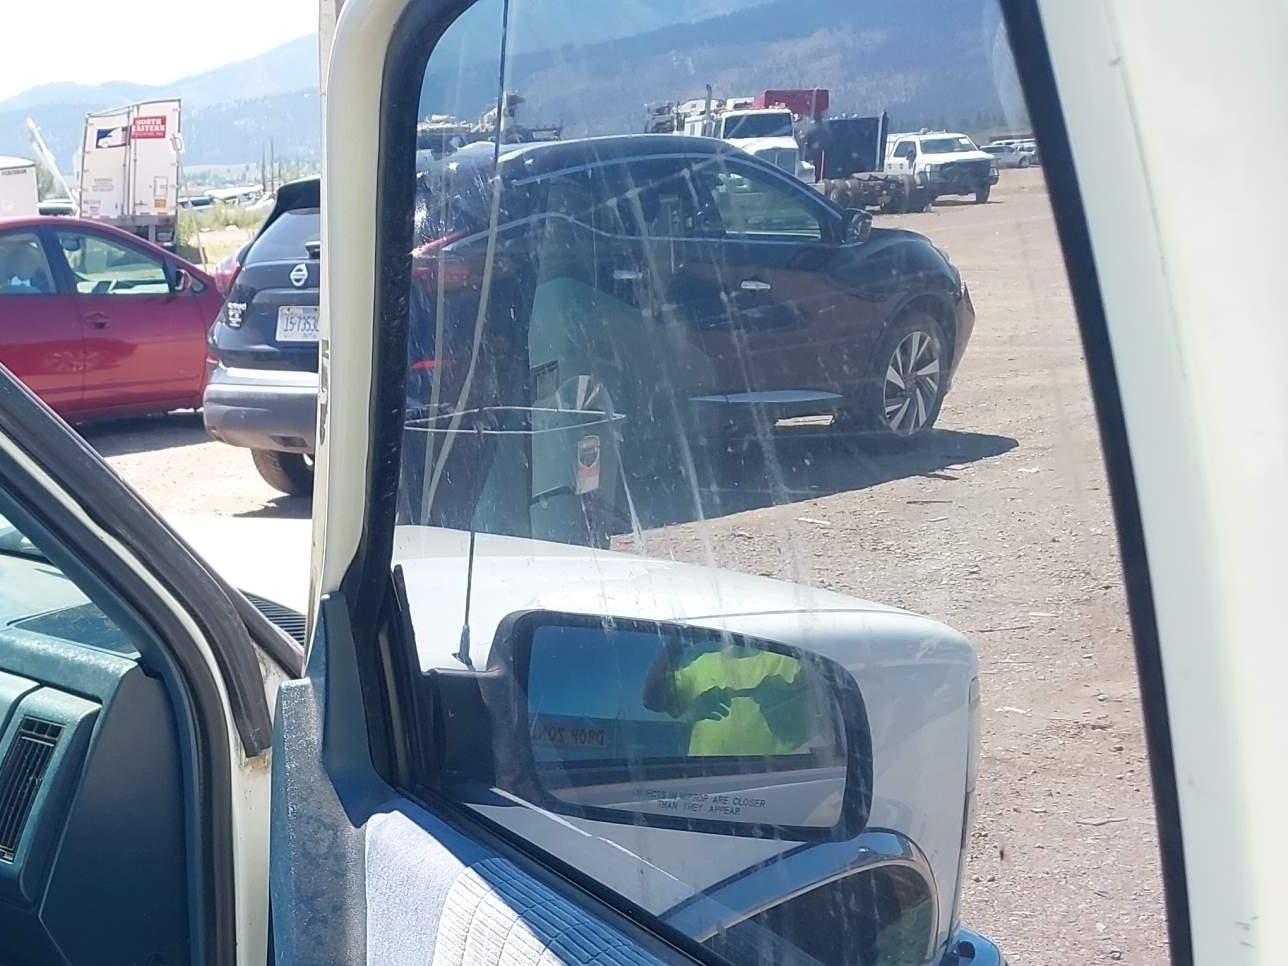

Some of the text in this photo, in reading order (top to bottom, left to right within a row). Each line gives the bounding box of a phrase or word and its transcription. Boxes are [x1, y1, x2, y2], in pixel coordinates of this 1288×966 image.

[657, 800, 678, 809] THAN
[712, 795, 729, 805] ARE
[732, 798, 766, 808] CLOSER
